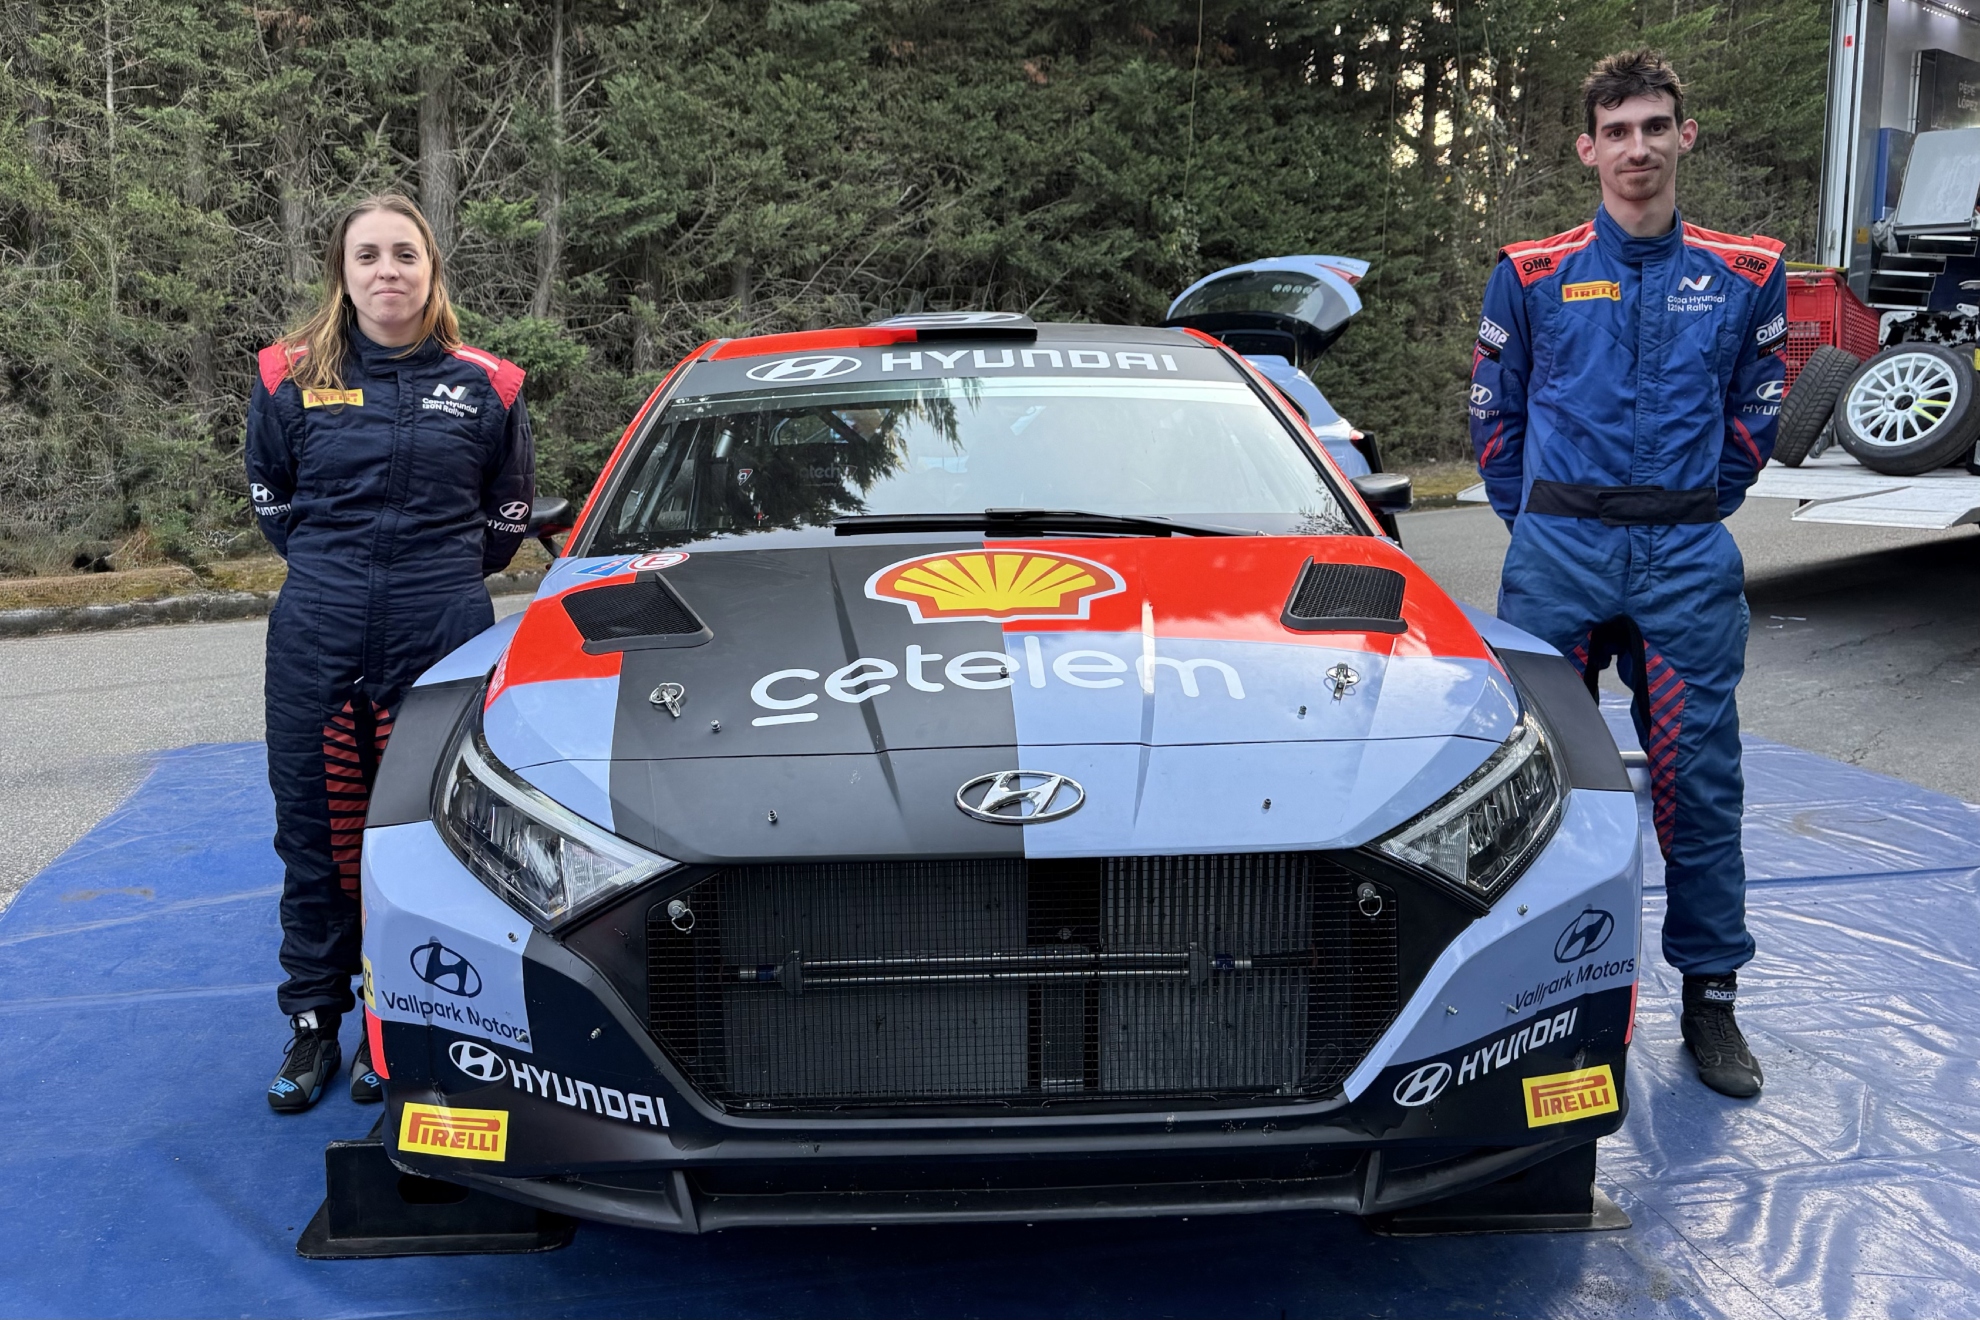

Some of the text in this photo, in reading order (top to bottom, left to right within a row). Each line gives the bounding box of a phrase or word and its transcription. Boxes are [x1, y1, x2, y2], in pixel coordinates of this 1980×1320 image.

[1522, 257, 1552, 272] OMP
[1735, 255, 1767, 272] OMP
[1686, 302, 1713, 312] Rallye
[1479, 320, 1508, 345] OMP
[1756, 317, 1787, 342] OMP
[880, 349, 1178, 373] HYUNDAI
[750, 635, 1246, 711] cetelem
[1575, 957, 1635, 986] Motors
[381, 990, 465, 1024] Vallpark
[1457, 1006, 1579, 1086] HYUNDAI
[272, 1079, 295, 1094] OMP
[508, 1058, 671, 1128] HYUNDAI
[1530, 1073, 1612, 1119] PIRELLI
[407, 1111, 502, 1153] PIRELLI
